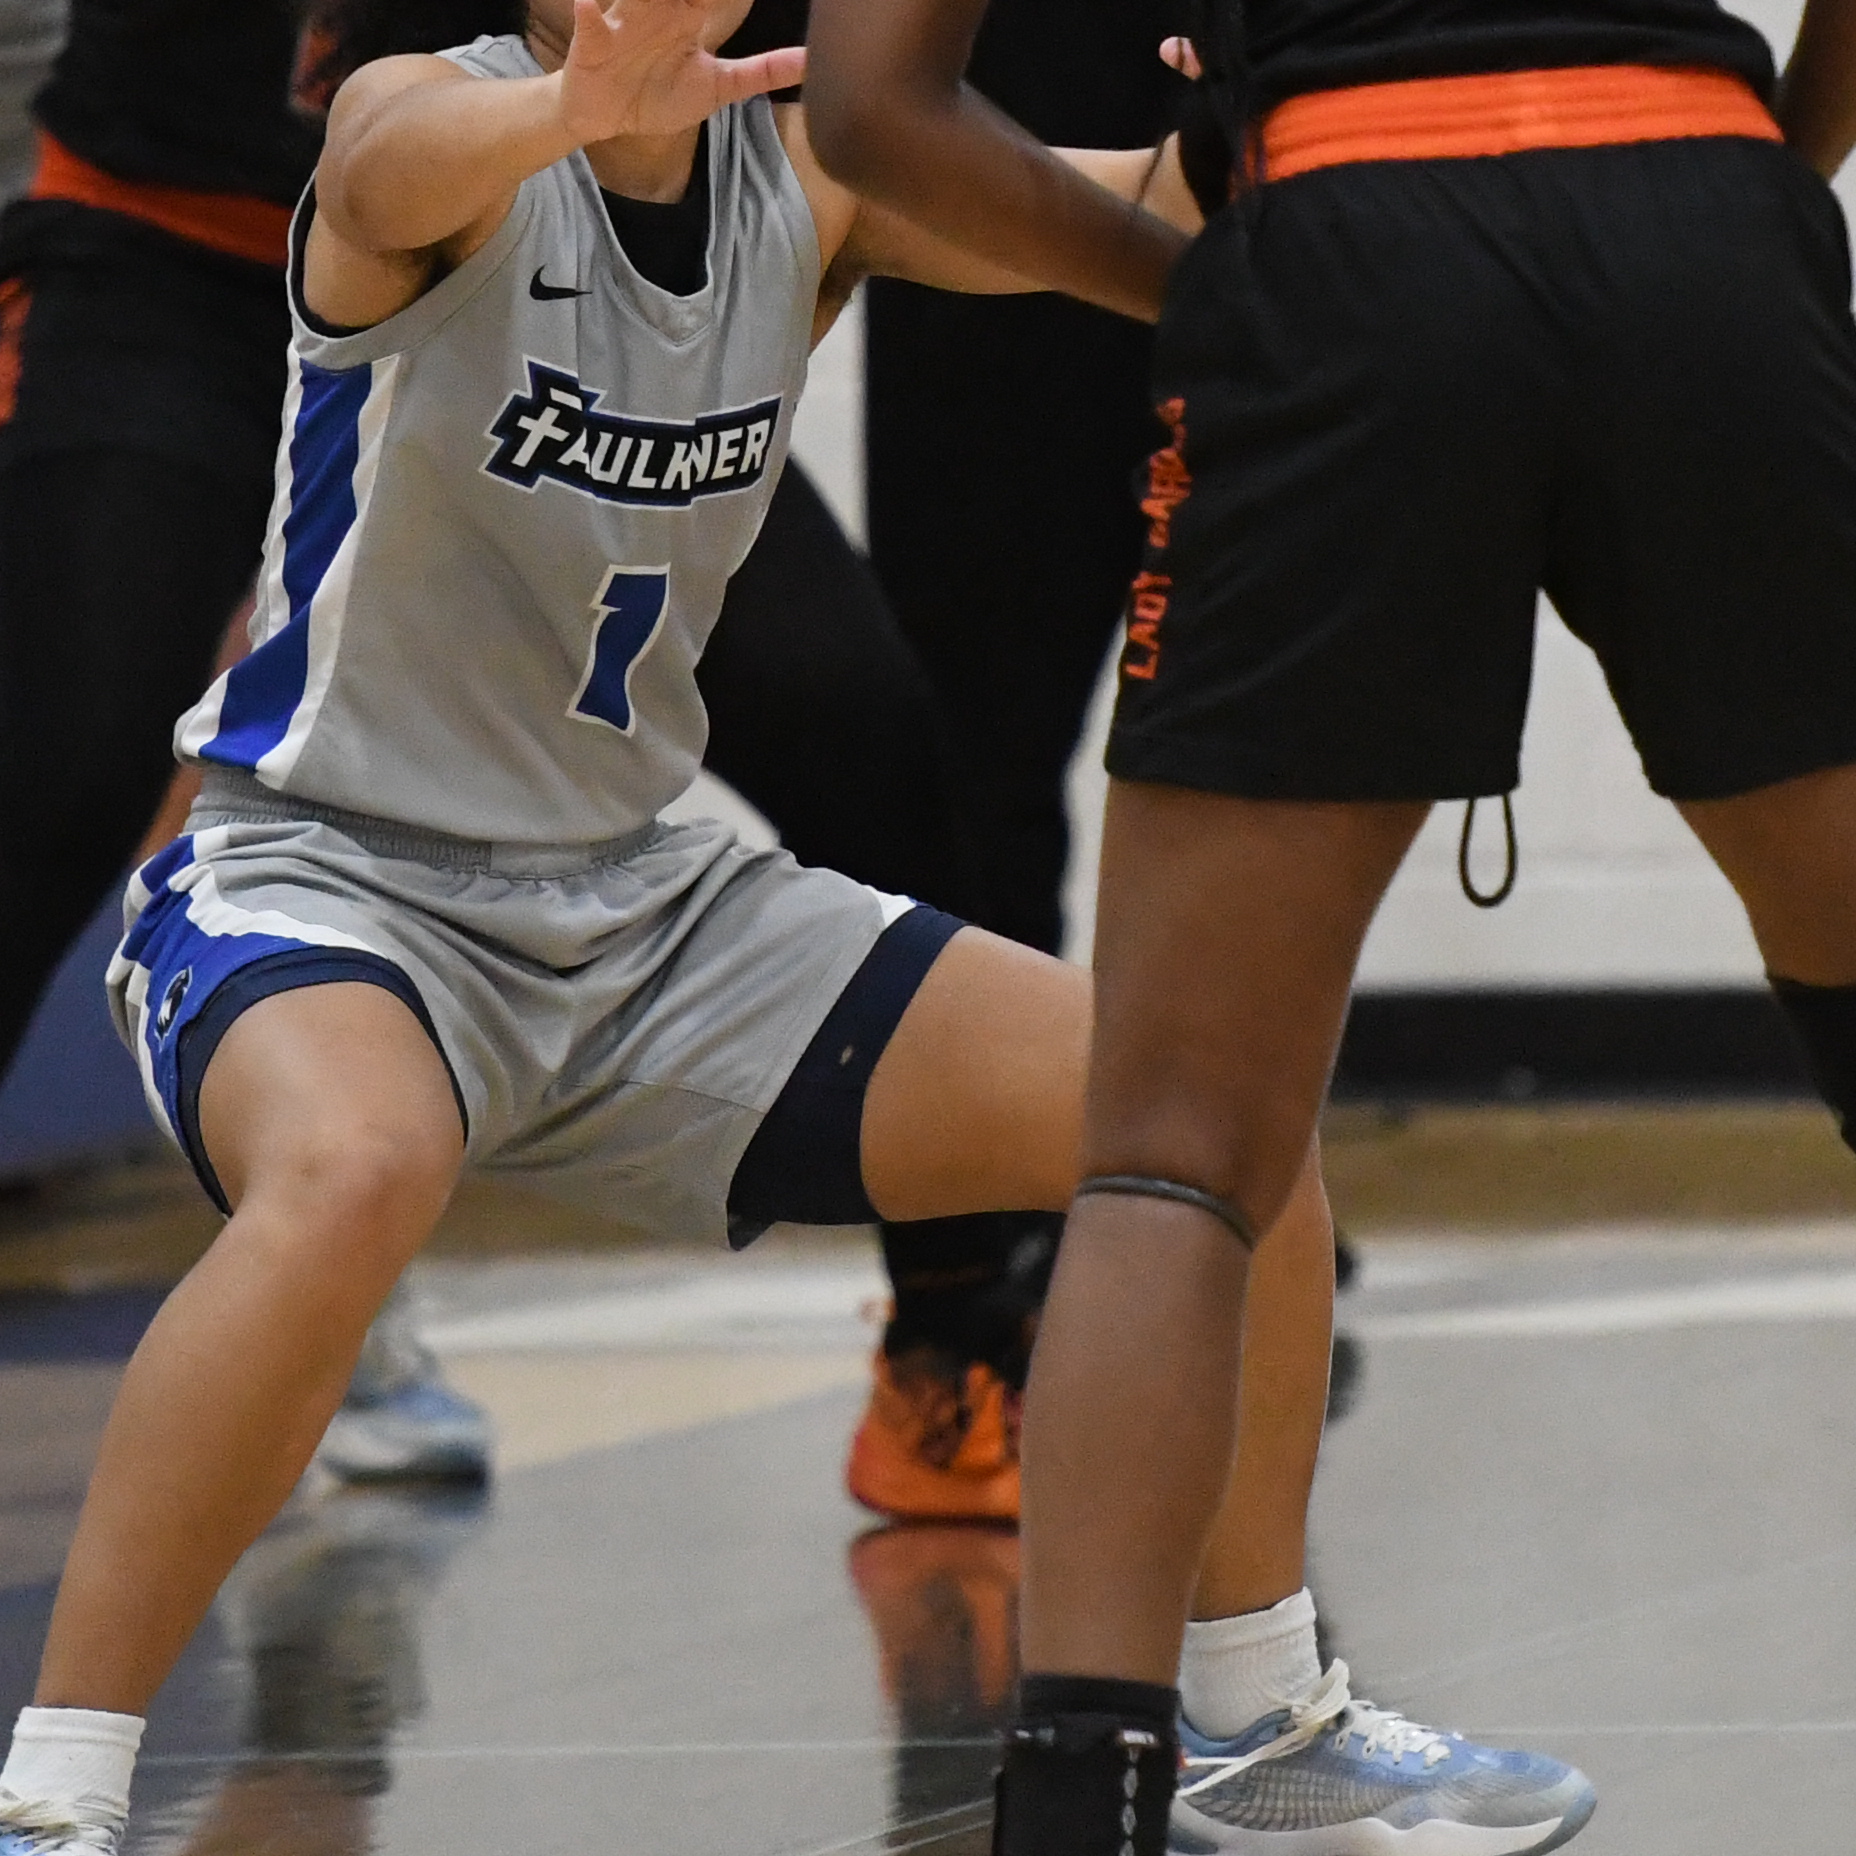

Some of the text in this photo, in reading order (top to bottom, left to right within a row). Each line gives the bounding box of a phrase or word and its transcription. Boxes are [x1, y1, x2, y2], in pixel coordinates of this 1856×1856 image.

[511, 386, 772, 492] FAULKNER
[564, 561, 672, 739] 1
[1125, 570, 1174, 681] LADY
